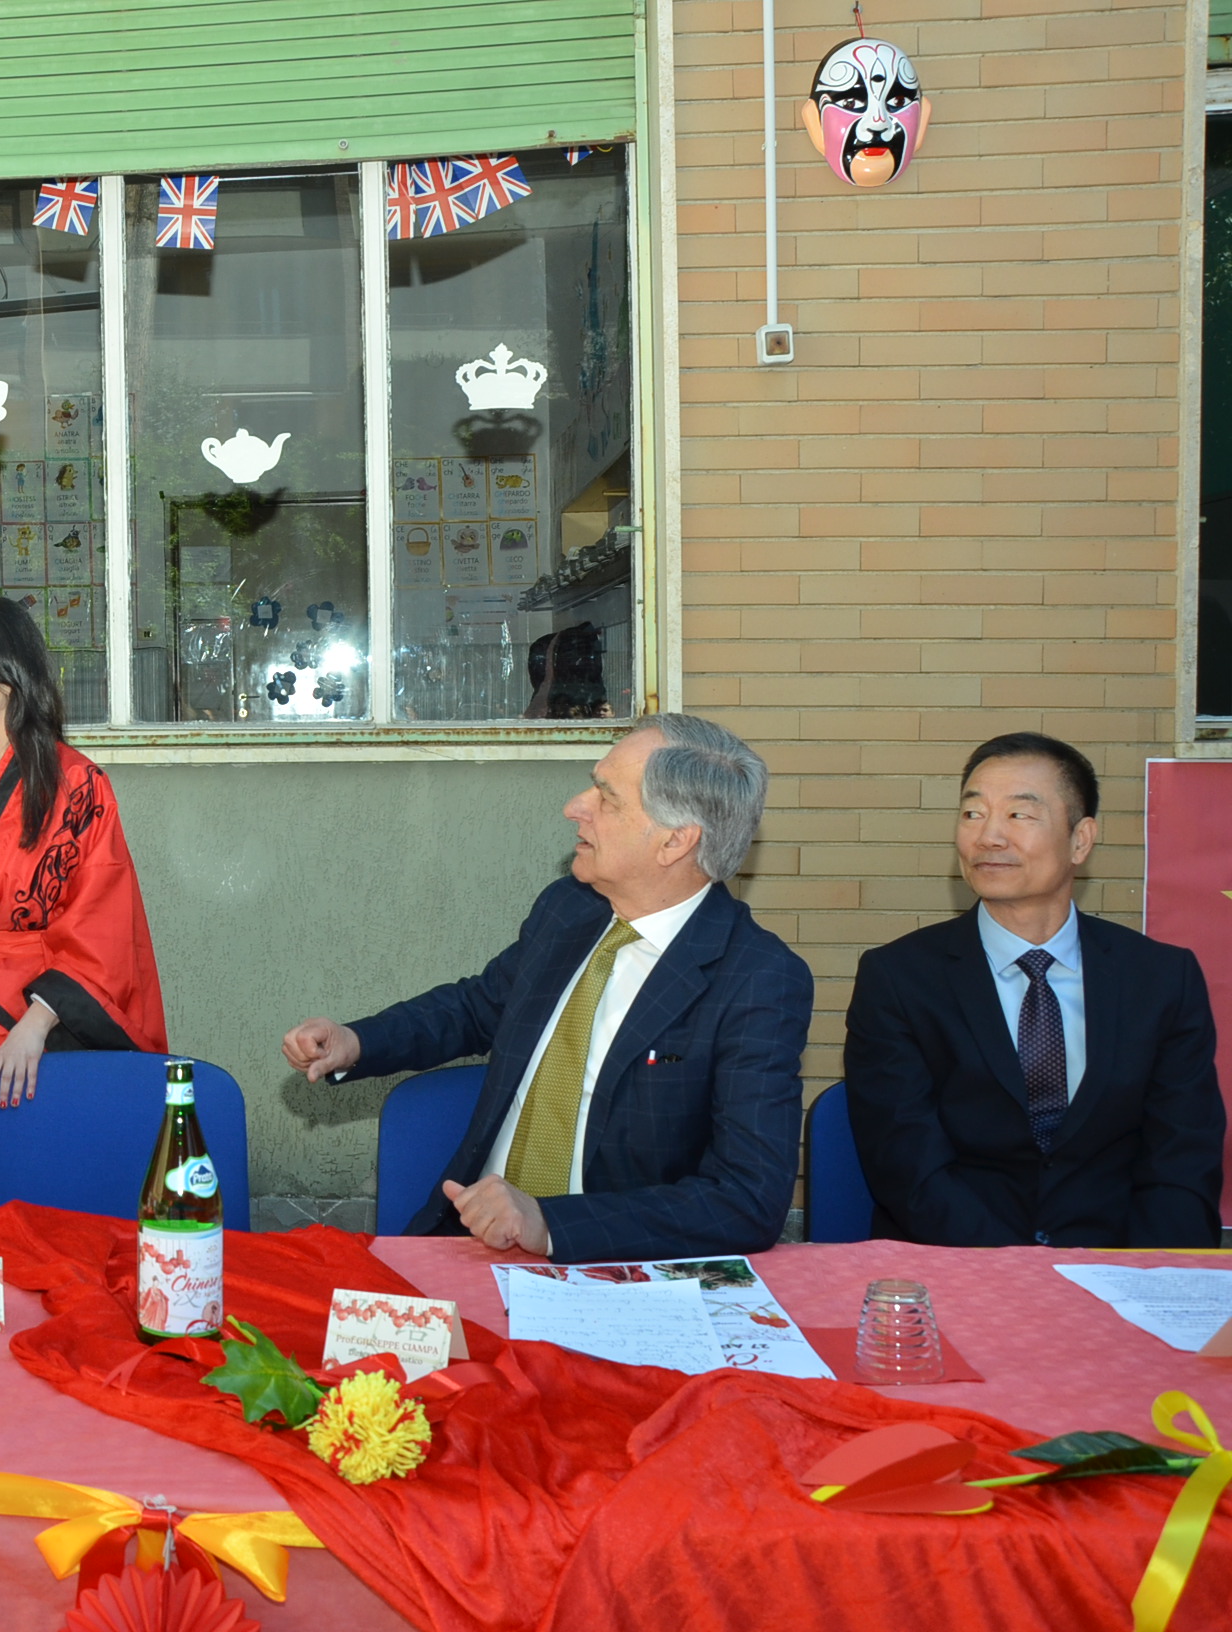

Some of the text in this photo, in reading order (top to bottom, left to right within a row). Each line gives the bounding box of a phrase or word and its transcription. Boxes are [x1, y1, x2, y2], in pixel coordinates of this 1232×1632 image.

[491, 467, 504, 475] ghe
[492, 533, 501, 541] ge
[452, 557, 480, 565] CIVETTA
[402, 1343, 439, 1355] CIAMPA
[400, 1356, 423, 1365] astico
